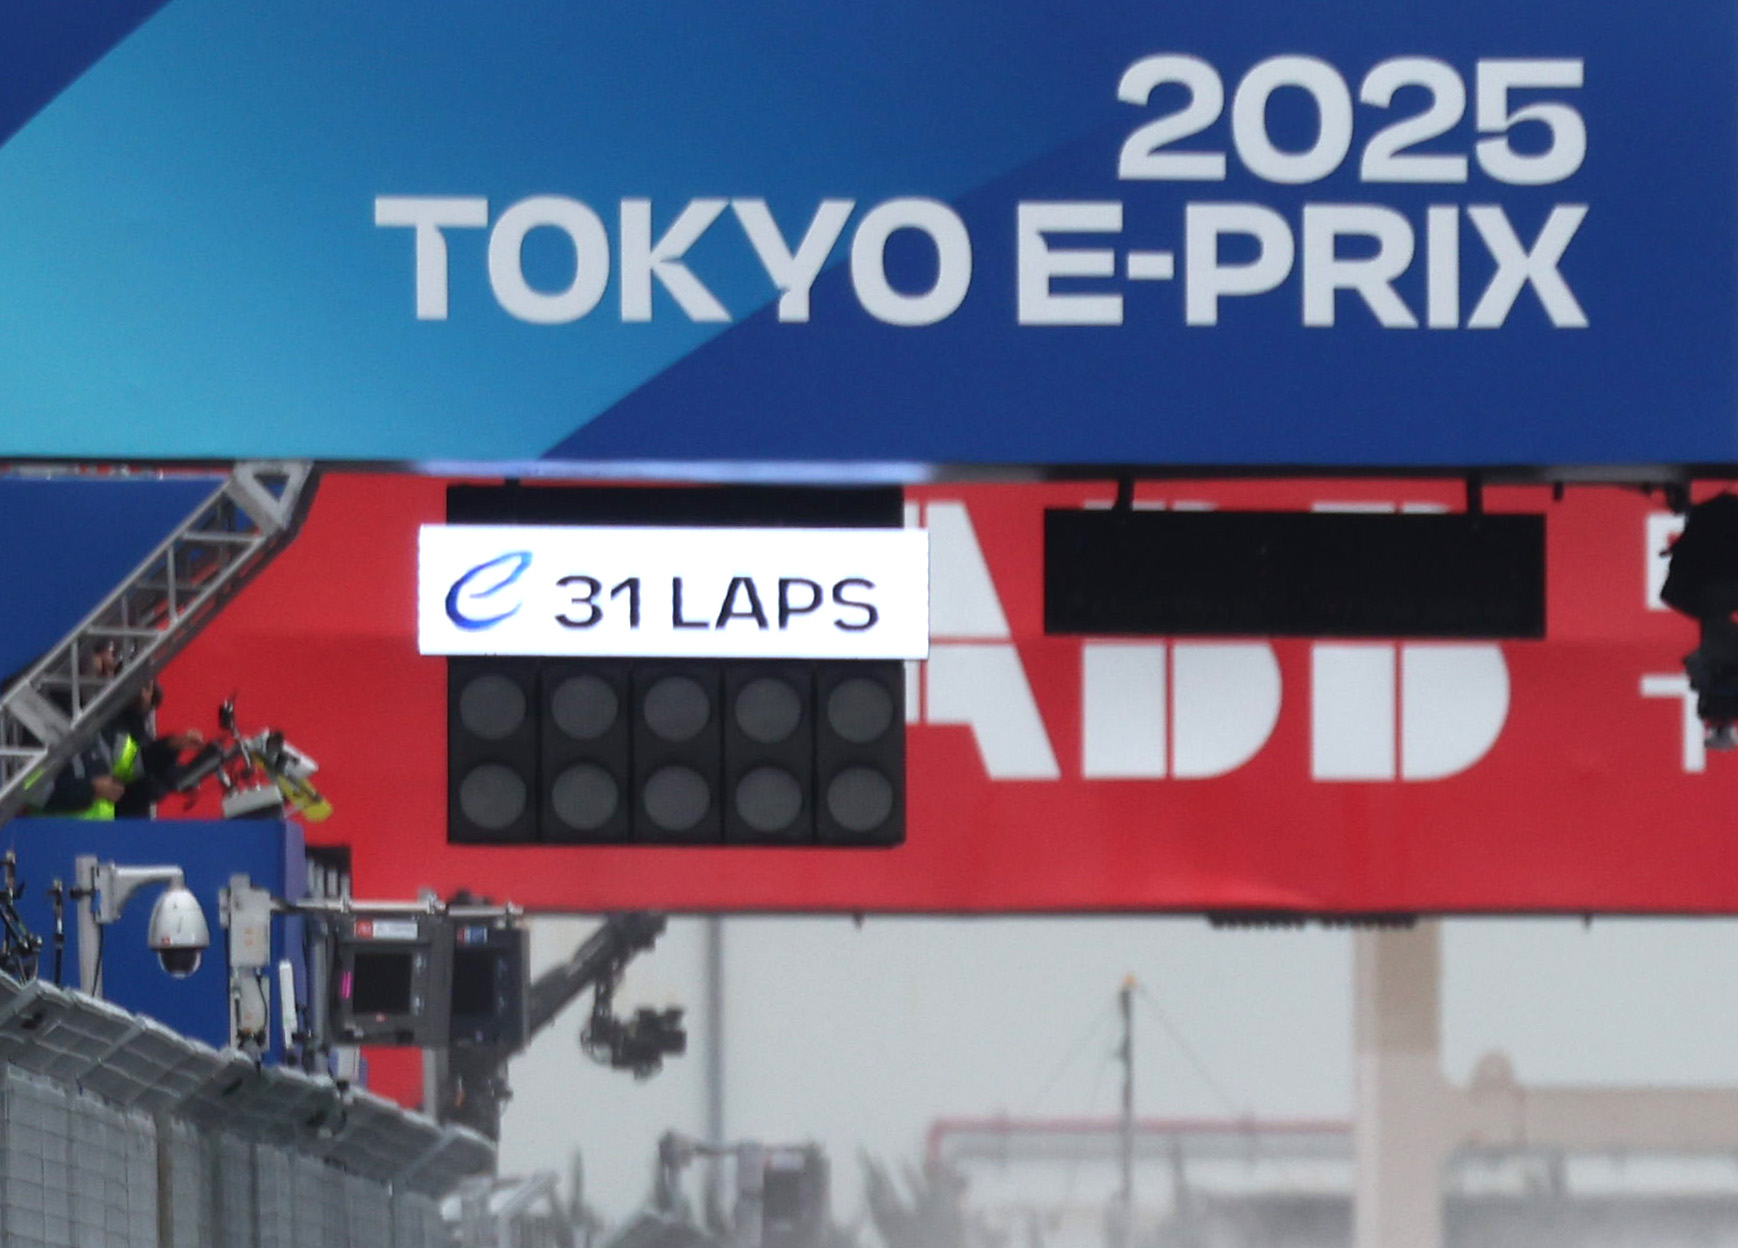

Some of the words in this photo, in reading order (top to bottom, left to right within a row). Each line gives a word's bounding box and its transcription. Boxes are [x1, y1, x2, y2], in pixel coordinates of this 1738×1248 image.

[1118, 56, 1585, 183] 2025
[375, 197, 971, 324] TOKYO
[1018, 203, 1586, 327] E-PRIX
[555, 575, 641, 631] 31
[671, 576, 879, 632] LAPS
